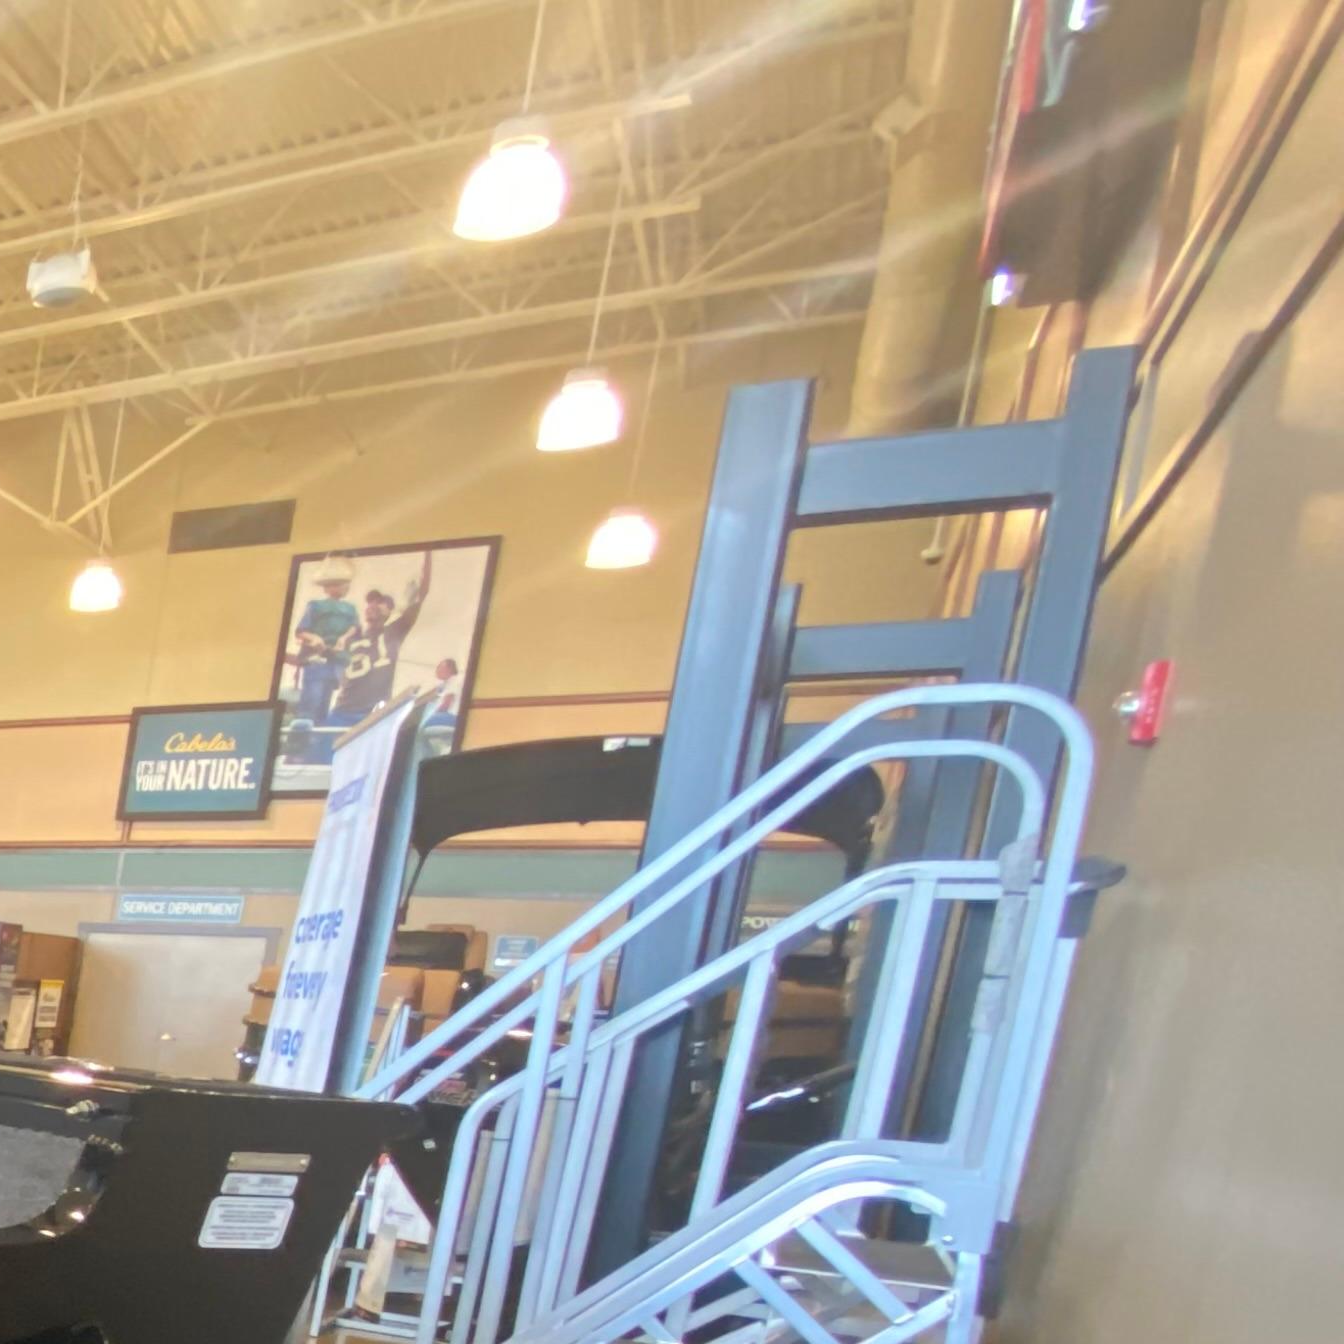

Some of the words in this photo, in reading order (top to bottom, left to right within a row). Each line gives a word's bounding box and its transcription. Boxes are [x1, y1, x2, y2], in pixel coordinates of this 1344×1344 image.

[164, 732, 237, 753] Cabela's
[136, 774, 166, 791] YOUR
[166, 757, 256, 791] NATURE.
